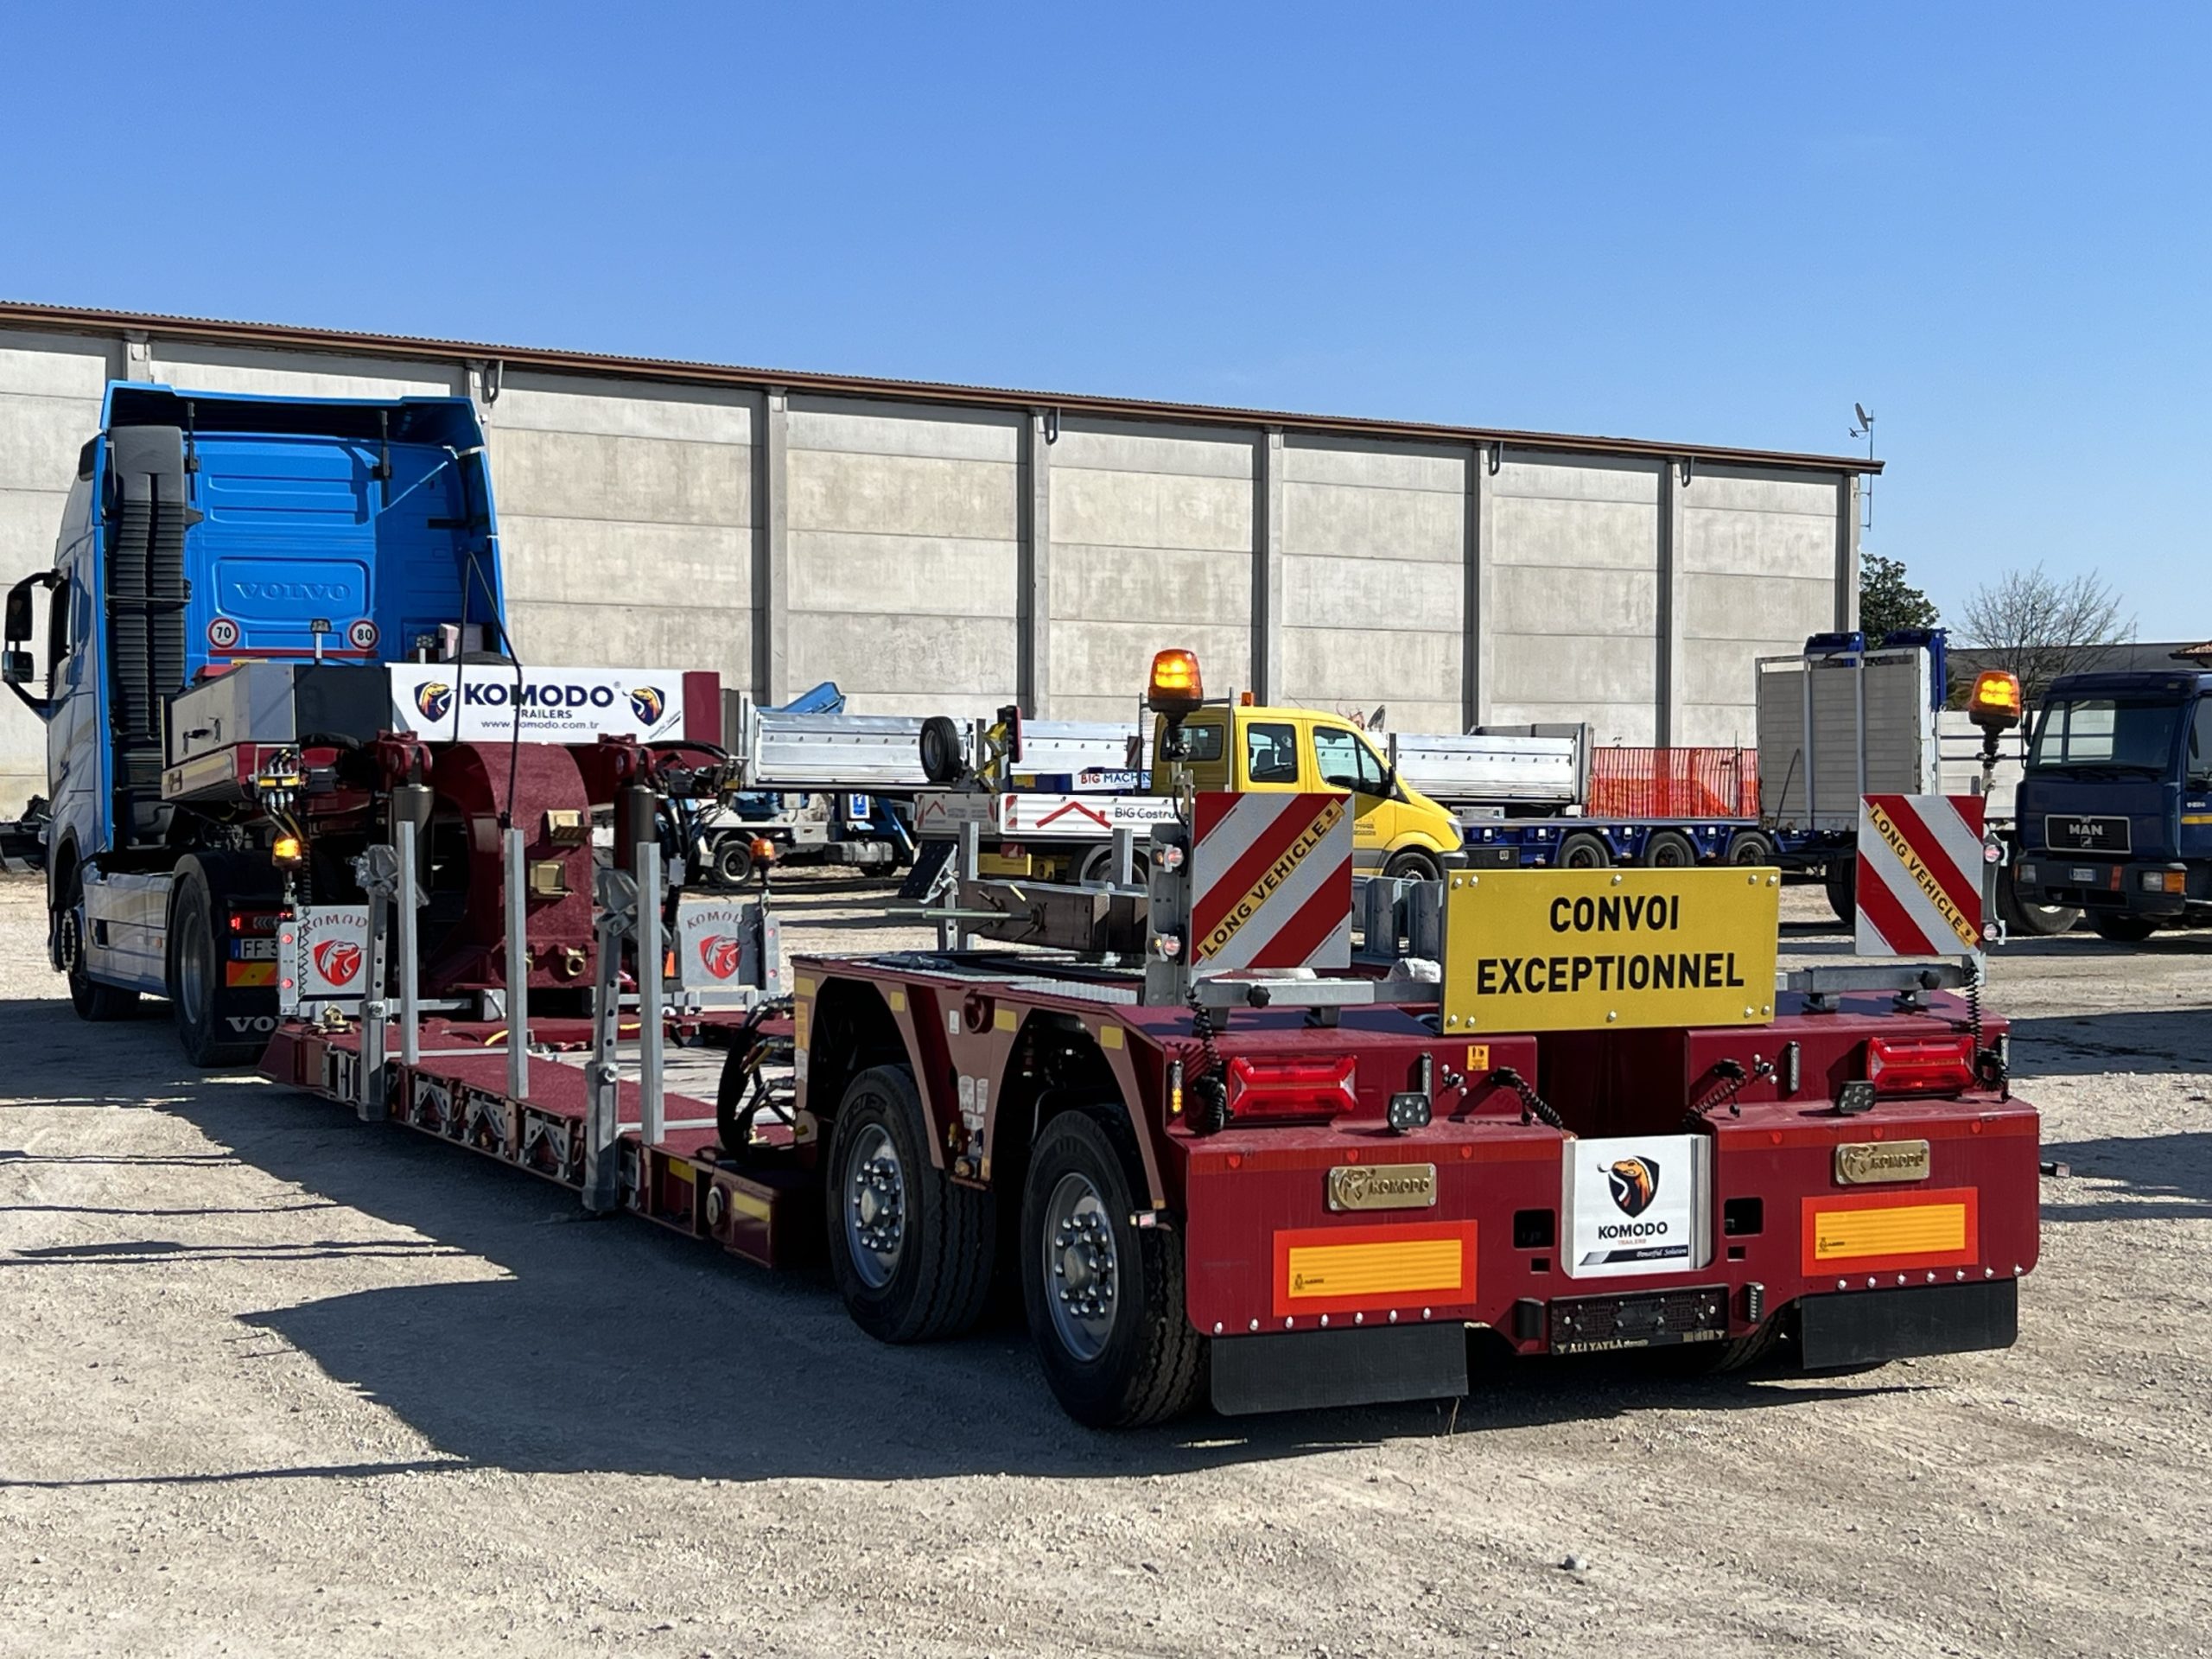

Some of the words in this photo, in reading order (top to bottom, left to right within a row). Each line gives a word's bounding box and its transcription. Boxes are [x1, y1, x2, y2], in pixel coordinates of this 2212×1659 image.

[232, 582, 351, 601] VOLVO
[216, 626, 232, 639] 70
[357, 628, 372, 641] 80
[463, 683, 614, 708] KOMODO
[513, 709, 573, 719] RAILERS
[480, 720, 600, 730] www.omodo.com.tr
[1080, 773, 1101, 785] BIG
[1103, 772, 1152, 784] MACHN
[2069, 823, 2103, 836] MAN
[1871, 809, 1908, 858] LONG
[1909, 858, 1962, 931] VEHICLE
[1202, 902, 1252, 956] LONG
[1251, 821, 1327, 900] VEHICLE
[1549, 895, 1679, 932] CONVOI
[243, 938, 263, 957] FF
[1477, 952, 1745, 995] EXCEPTIONNEL
[1368, 1178, 1430, 1195] KOMODO
[1598, 1221, 1669, 1240] KOMODO
